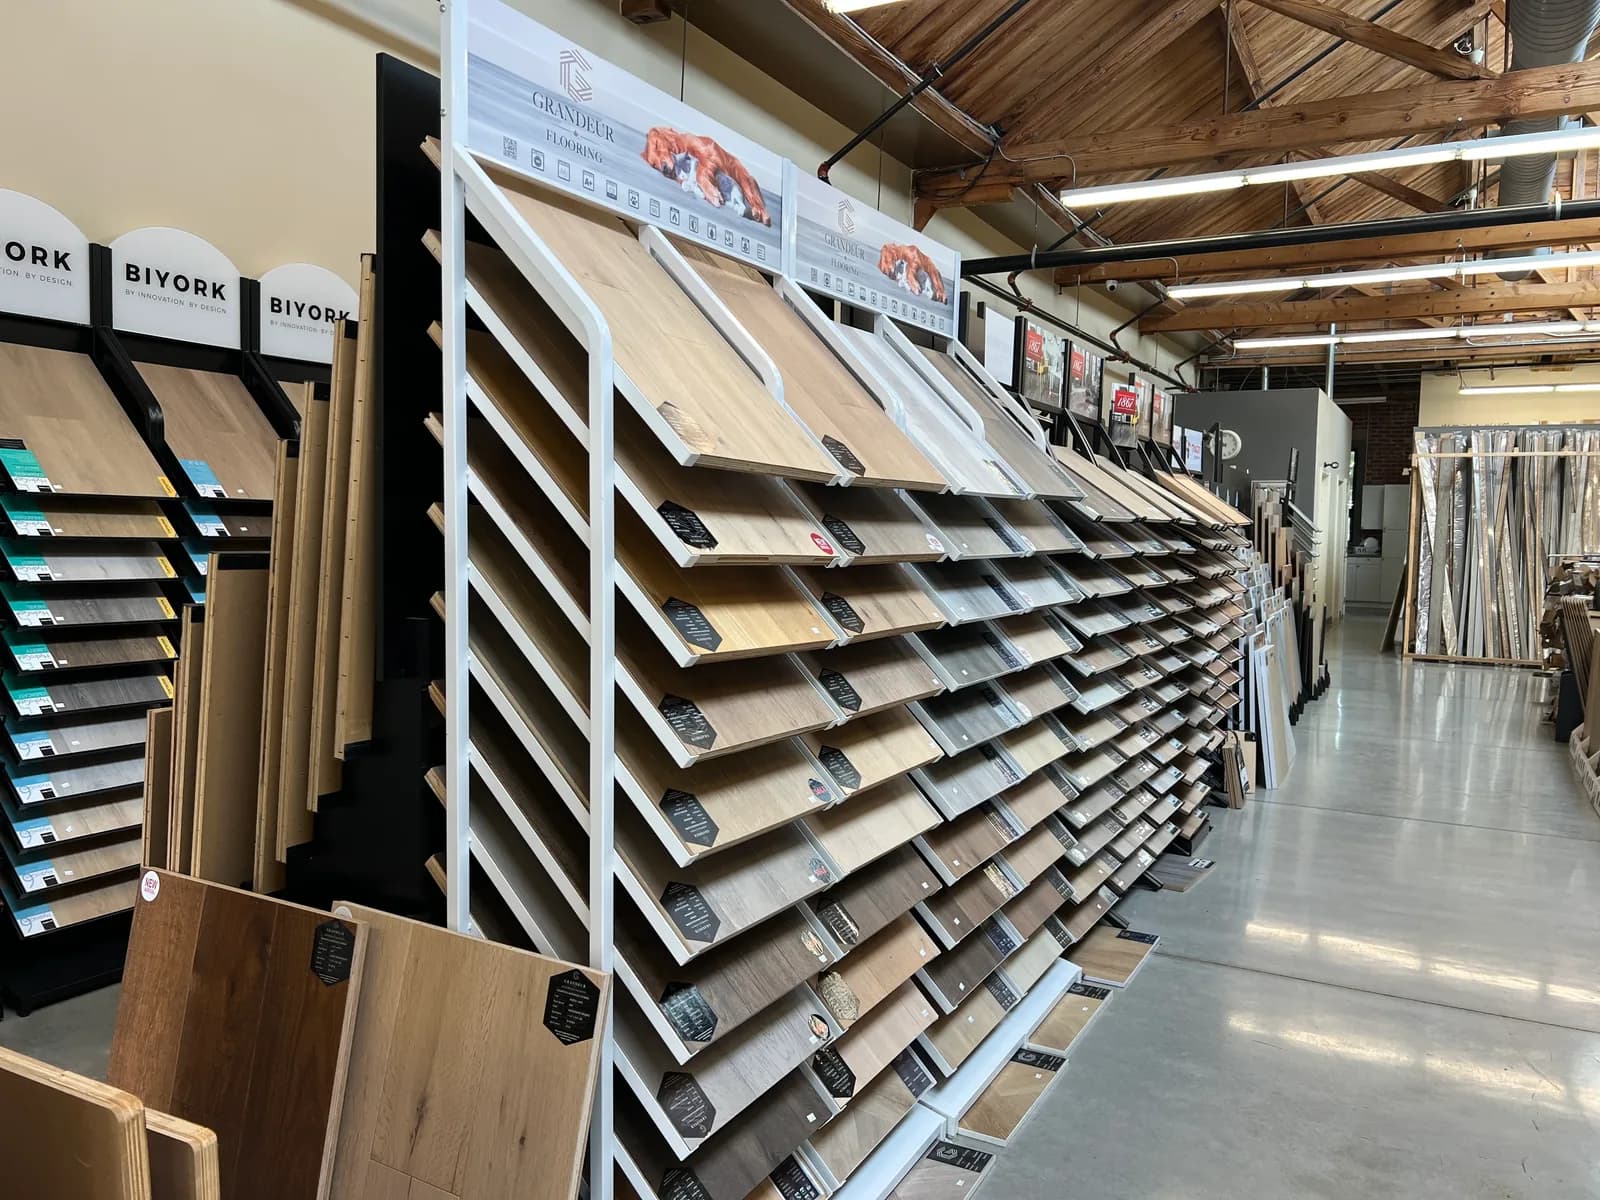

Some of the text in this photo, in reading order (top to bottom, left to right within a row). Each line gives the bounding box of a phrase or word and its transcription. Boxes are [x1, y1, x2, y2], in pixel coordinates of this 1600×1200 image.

[532, 91, 614, 143] GRANDEUR
[546, 129, 603, 163] FLOORING
[39, 275, 72, 287] DESIGN
[125, 263, 226, 301] BIYORK
[138, 291, 185, 306] INNOVATION
[200, 303, 227, 314] DESIGN
